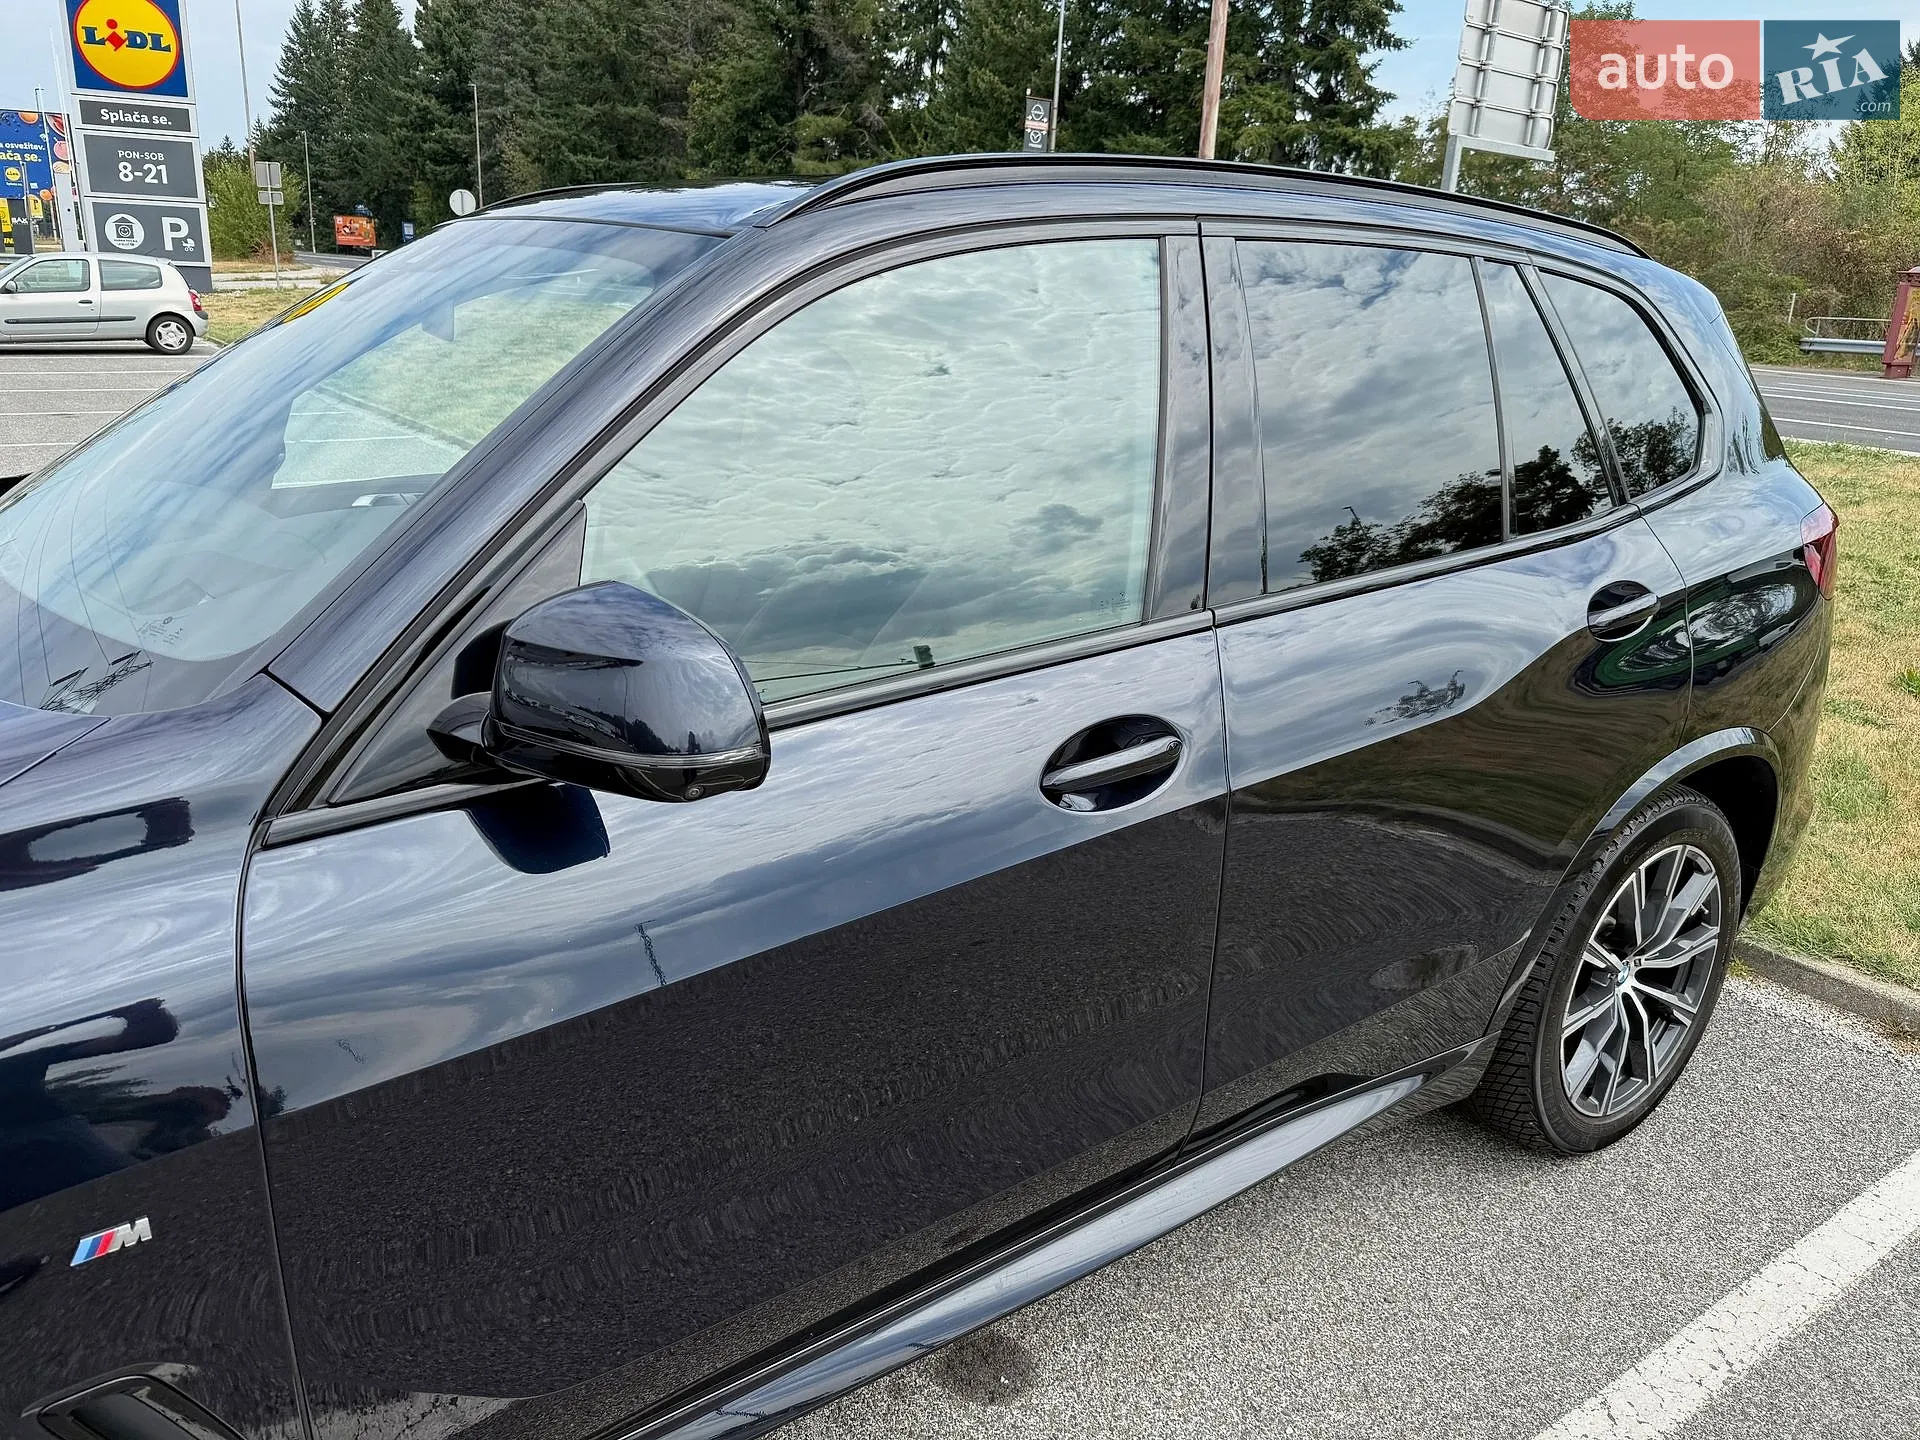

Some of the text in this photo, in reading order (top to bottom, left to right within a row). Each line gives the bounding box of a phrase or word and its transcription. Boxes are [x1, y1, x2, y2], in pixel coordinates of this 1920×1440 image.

[100, 108, 172, 125] Splača se.
[24, 152, 42, 162] se.
[117, 150, 165, 161] PON-SOB
[118, 161, 169, 185] 8-21
[161, 216, 189, 251] P
